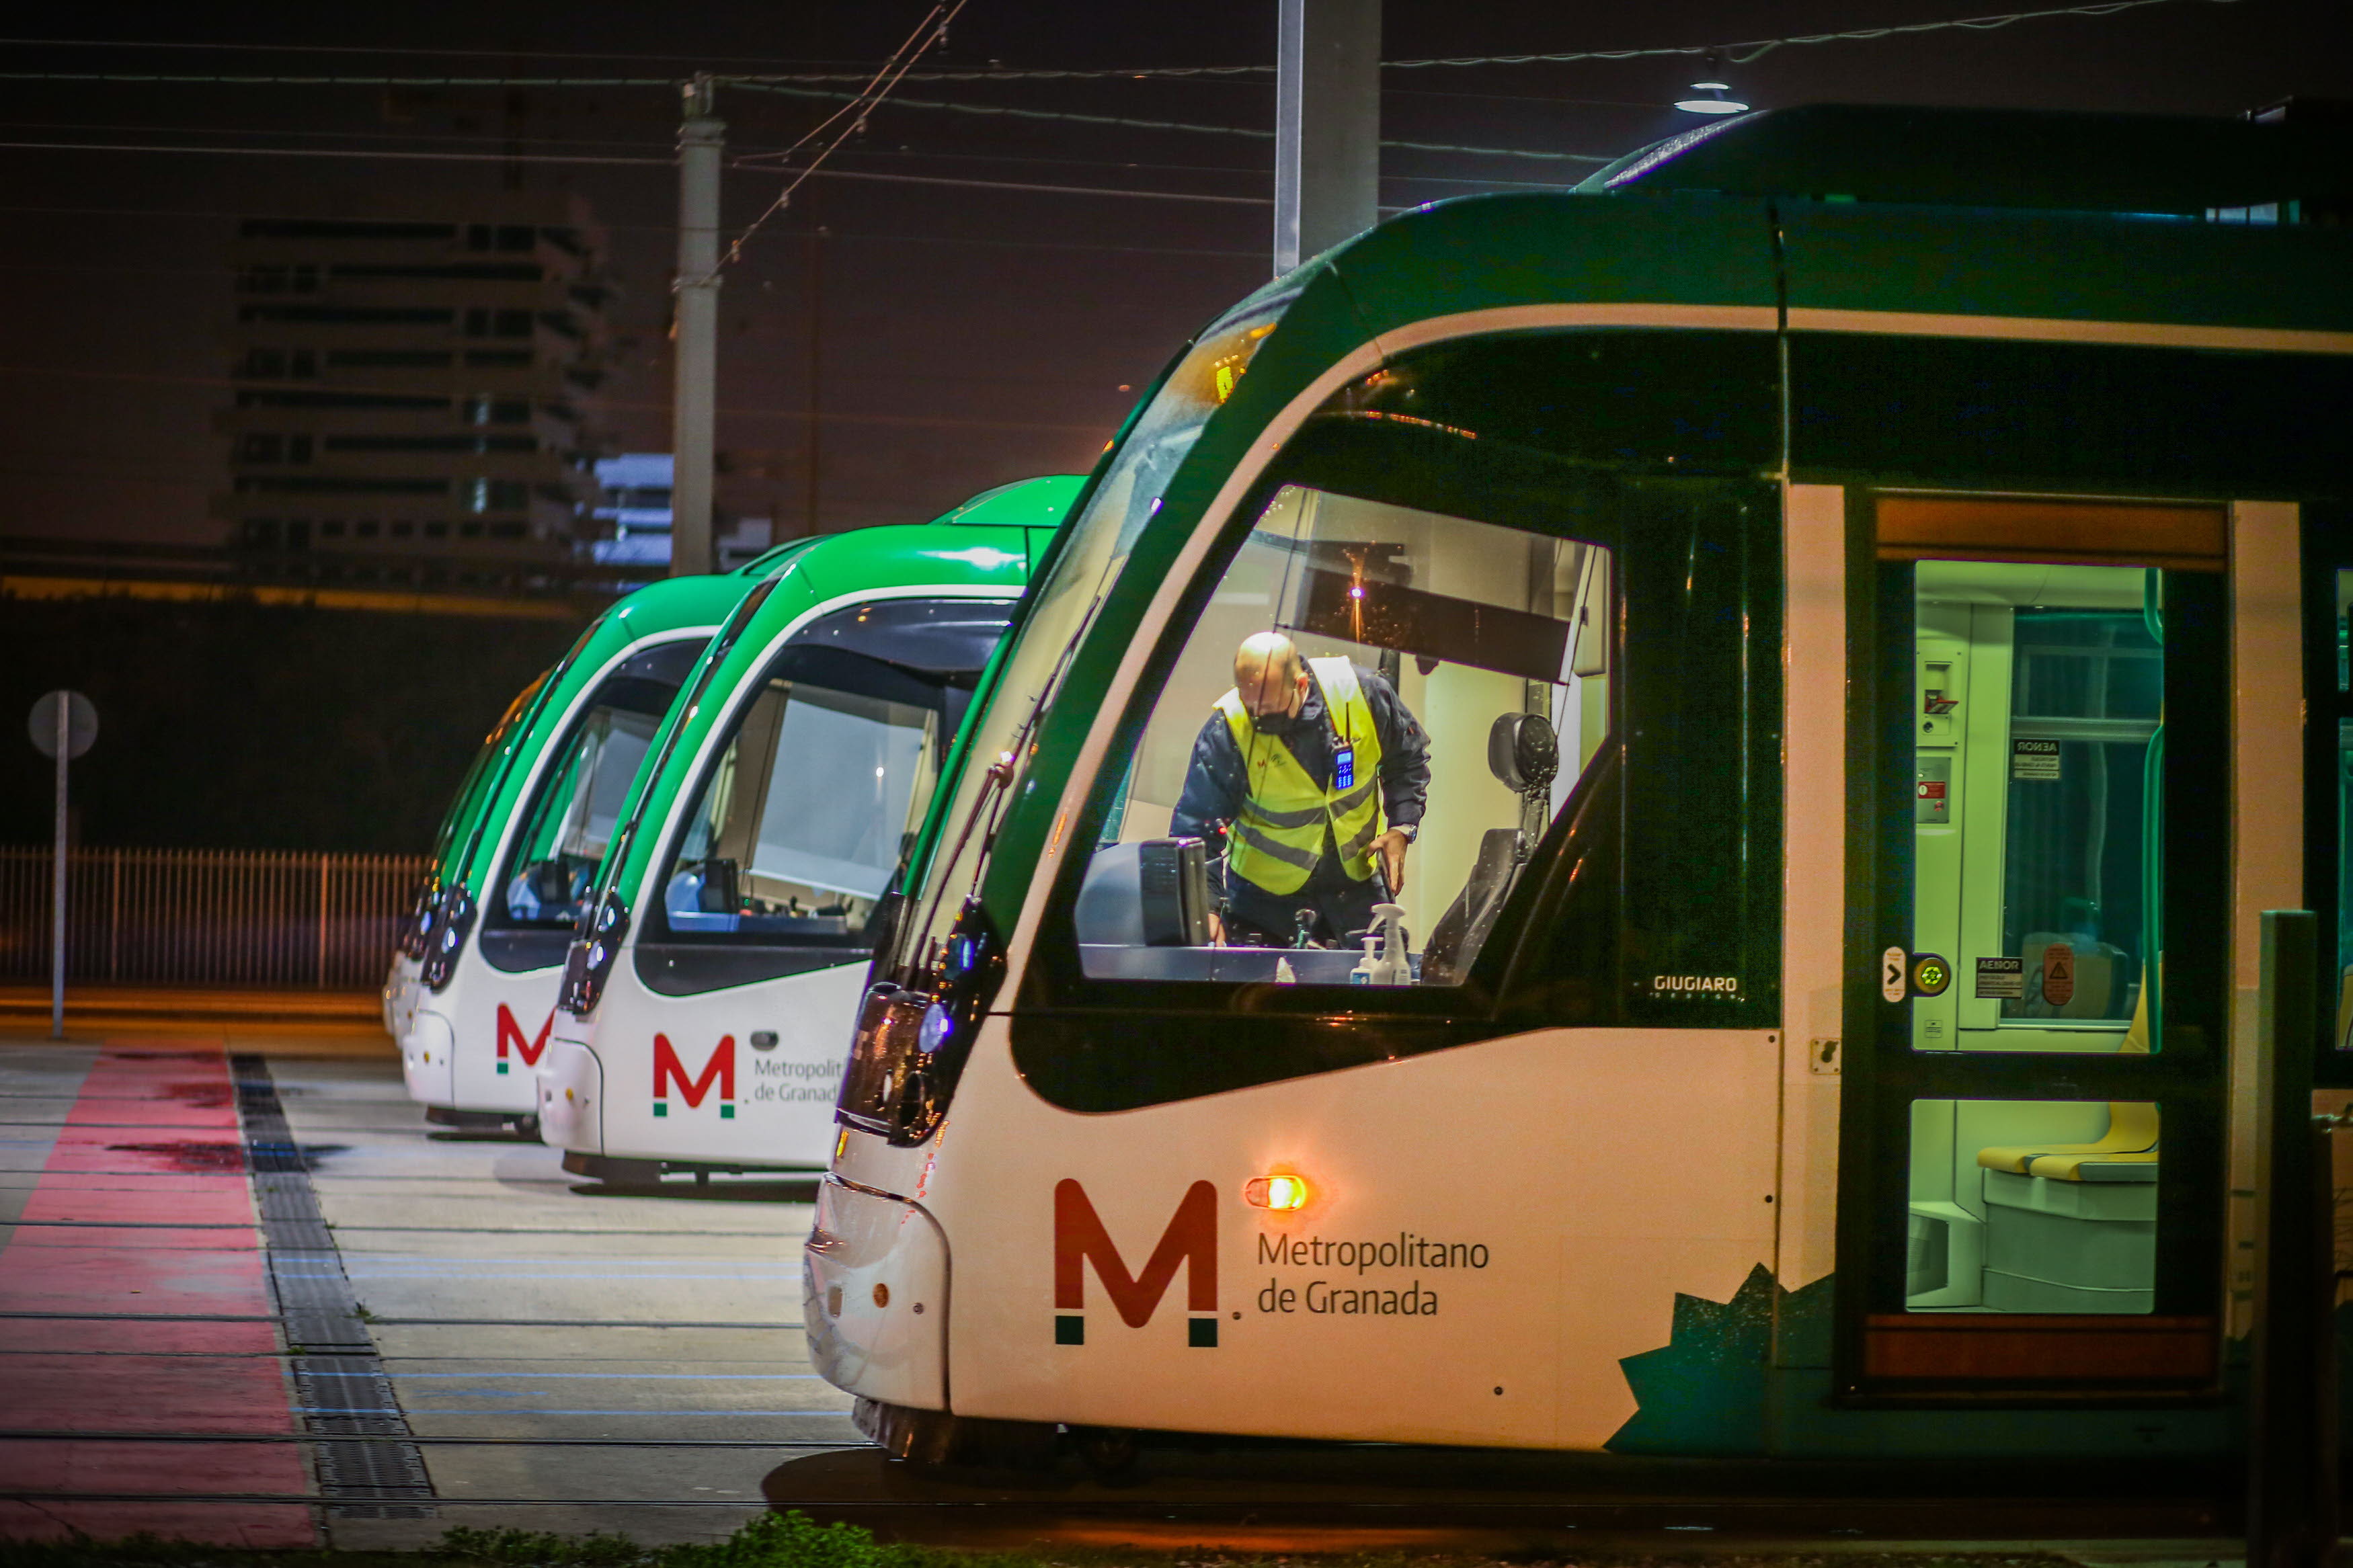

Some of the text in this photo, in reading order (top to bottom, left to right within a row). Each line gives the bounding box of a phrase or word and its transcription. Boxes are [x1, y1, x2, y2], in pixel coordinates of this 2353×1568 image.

[1979, 960, 2020, 971] AENOR
[1654, 975, 1737, 991] GIUGIARO
[653, 1032, 735, 1118] M
[754, 1059, 843, 1081] Metropolit
[754, 1081, 837, 1102] de Granad
[1054, 1178, 1218, 1348] M
[1258, 1231, 1489, 1275] Metropolitano
[1258, 1277, 1438, 1315] de Granada
